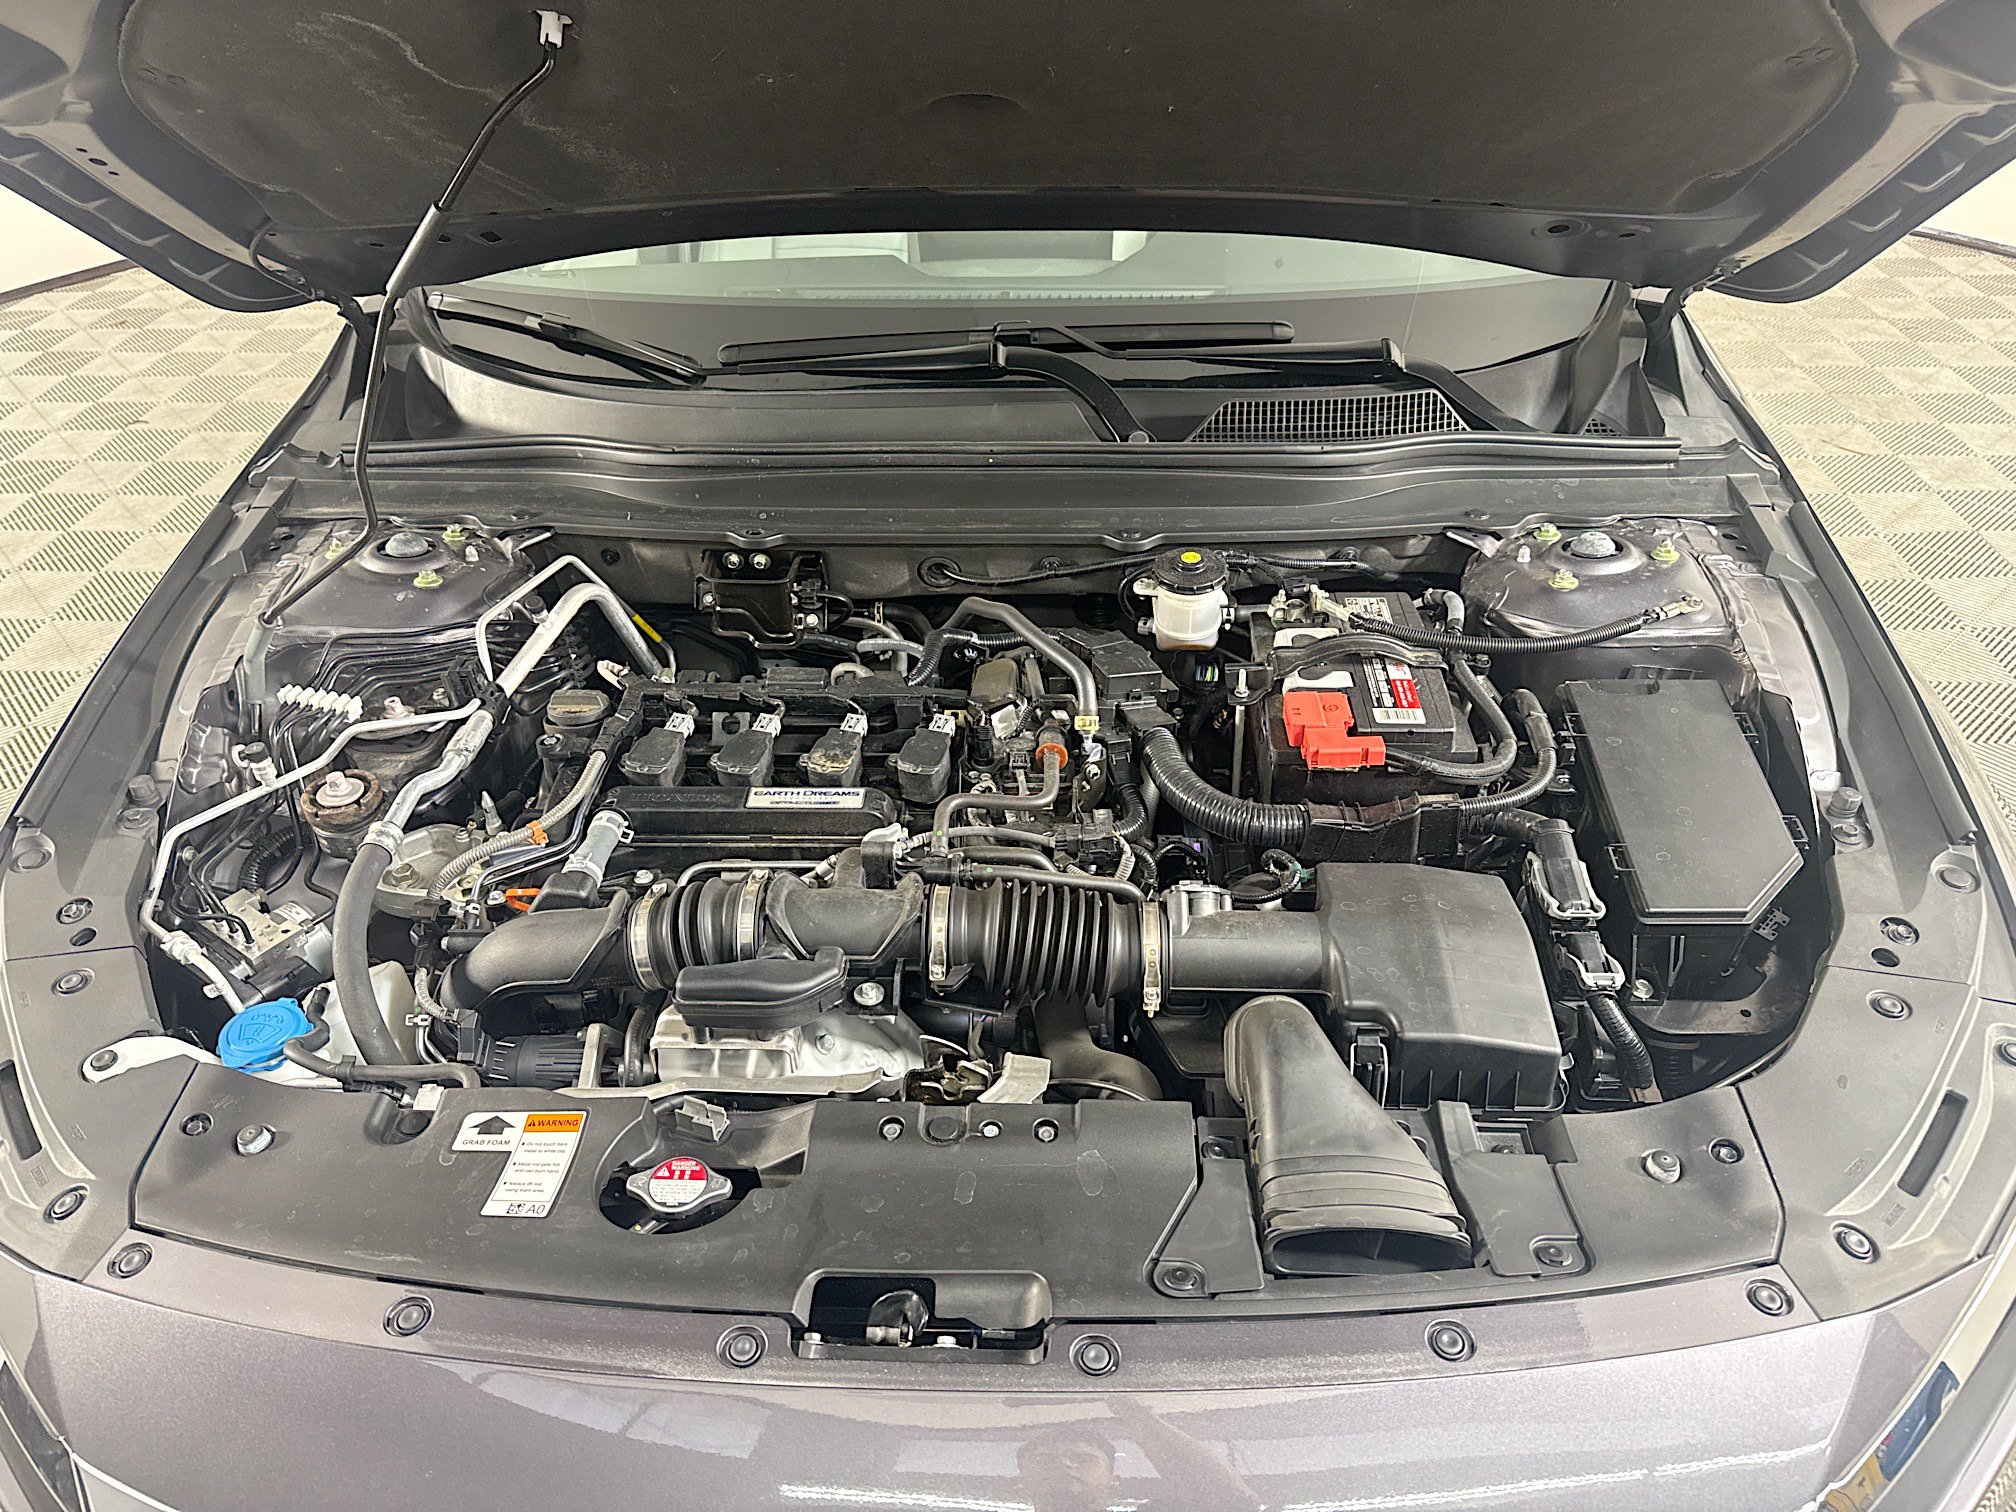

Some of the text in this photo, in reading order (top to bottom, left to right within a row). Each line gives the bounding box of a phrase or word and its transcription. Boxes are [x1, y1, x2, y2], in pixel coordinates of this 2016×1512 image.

[803, 789, 860, 797] DREAMS
[537, 1119, 579, 1127] WARNING
[525, 1204, 546, 1215] A0
